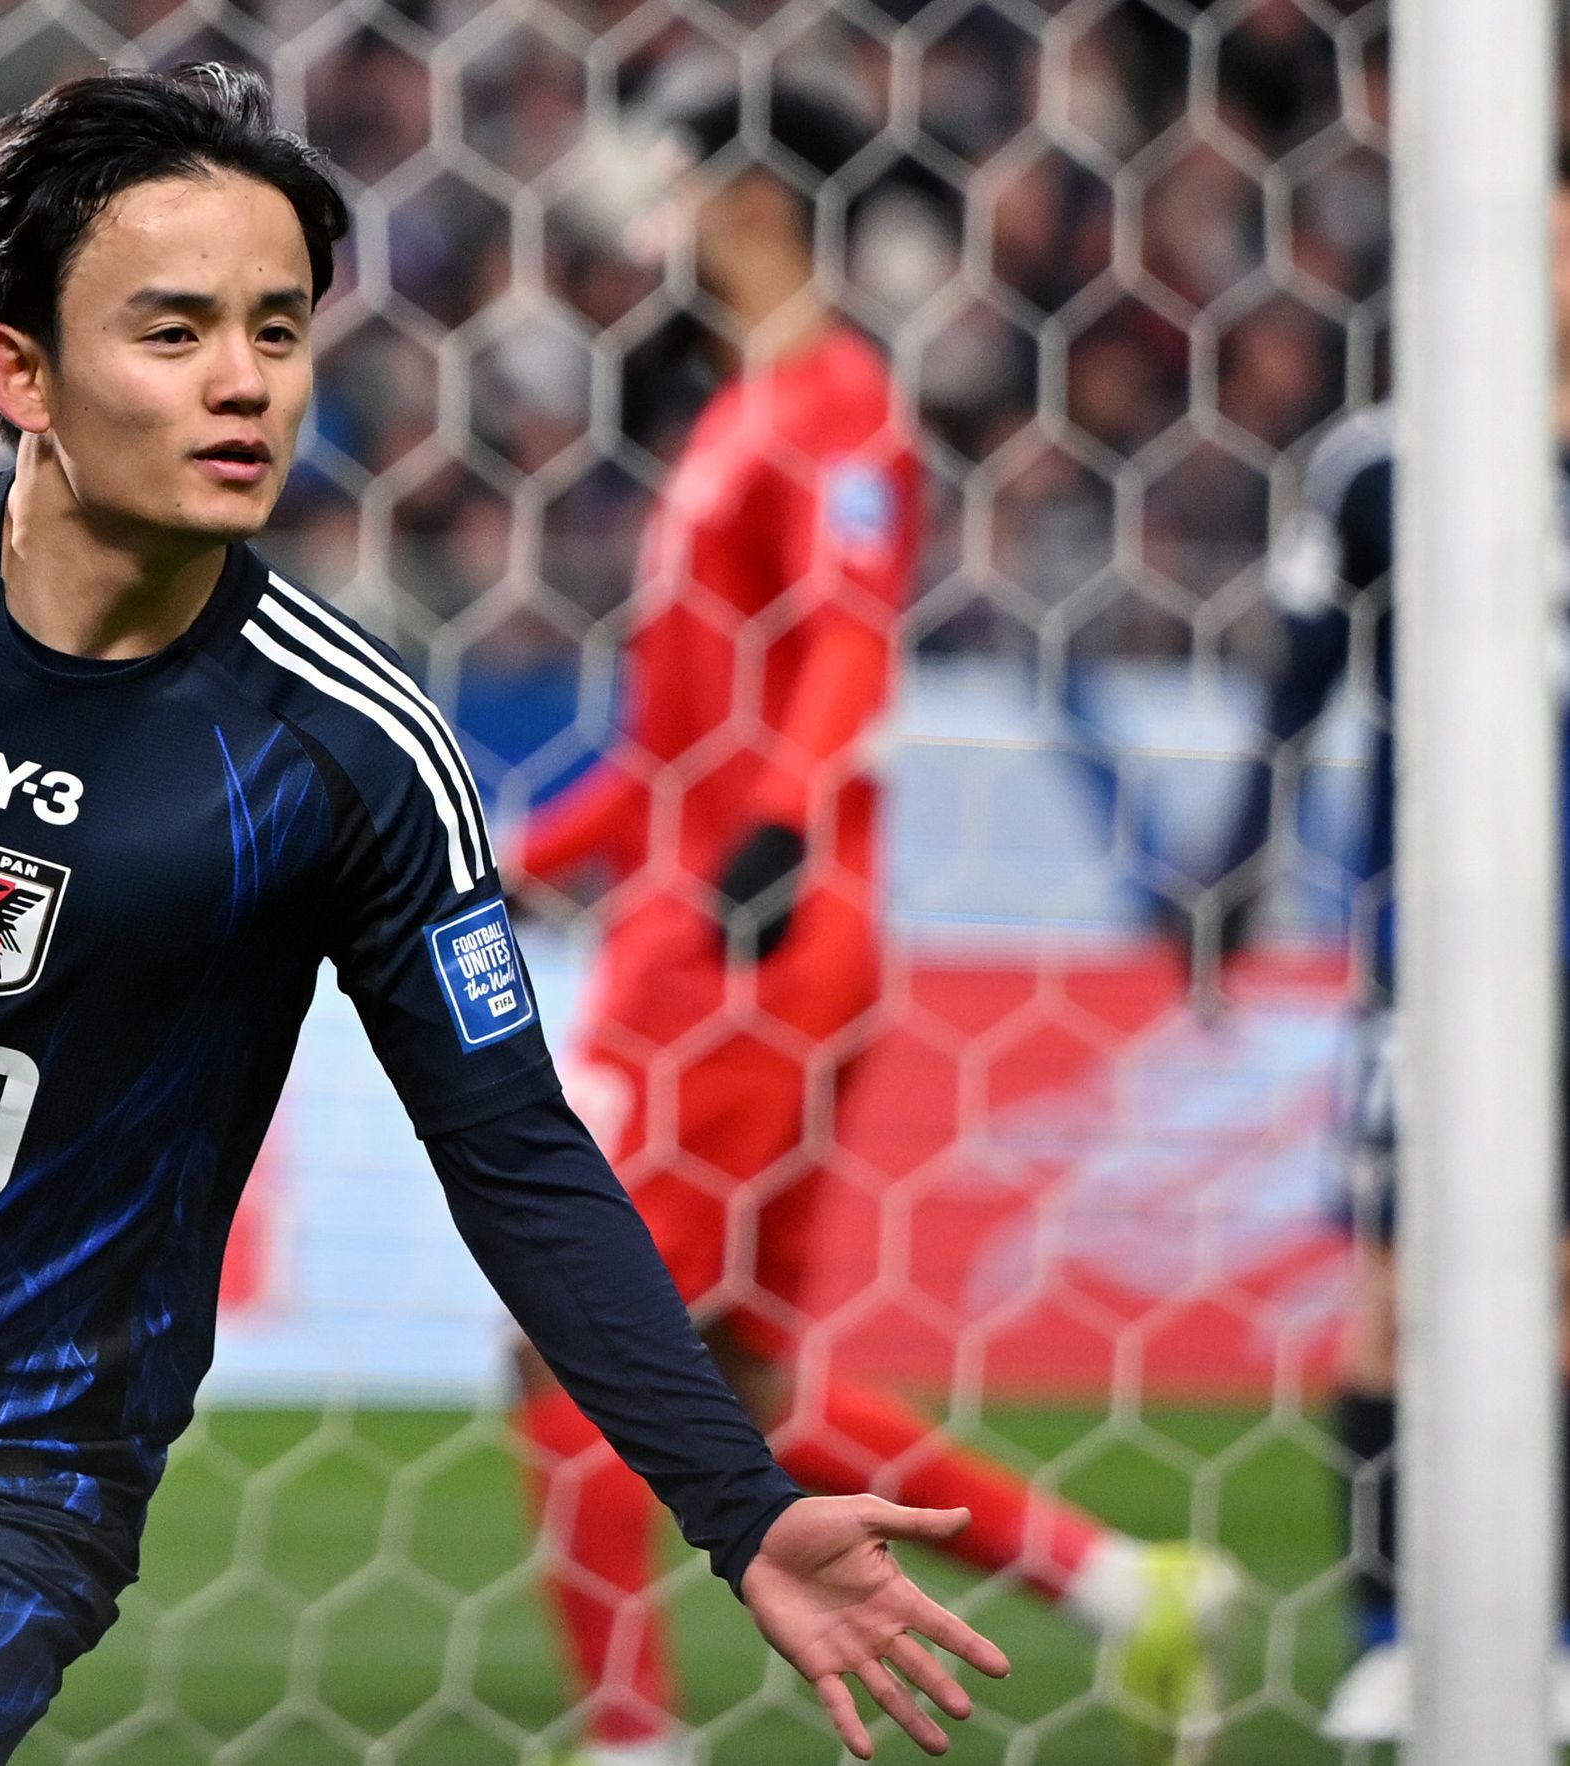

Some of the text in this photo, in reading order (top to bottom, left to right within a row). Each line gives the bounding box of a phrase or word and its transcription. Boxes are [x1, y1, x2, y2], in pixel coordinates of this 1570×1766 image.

[451, 920, 505, 956] FOOTBALL
[457, 938, 511, 979] UNITES
[463, 978, 490, 1002] the
[494, 996, 514, 1012] FIFA
